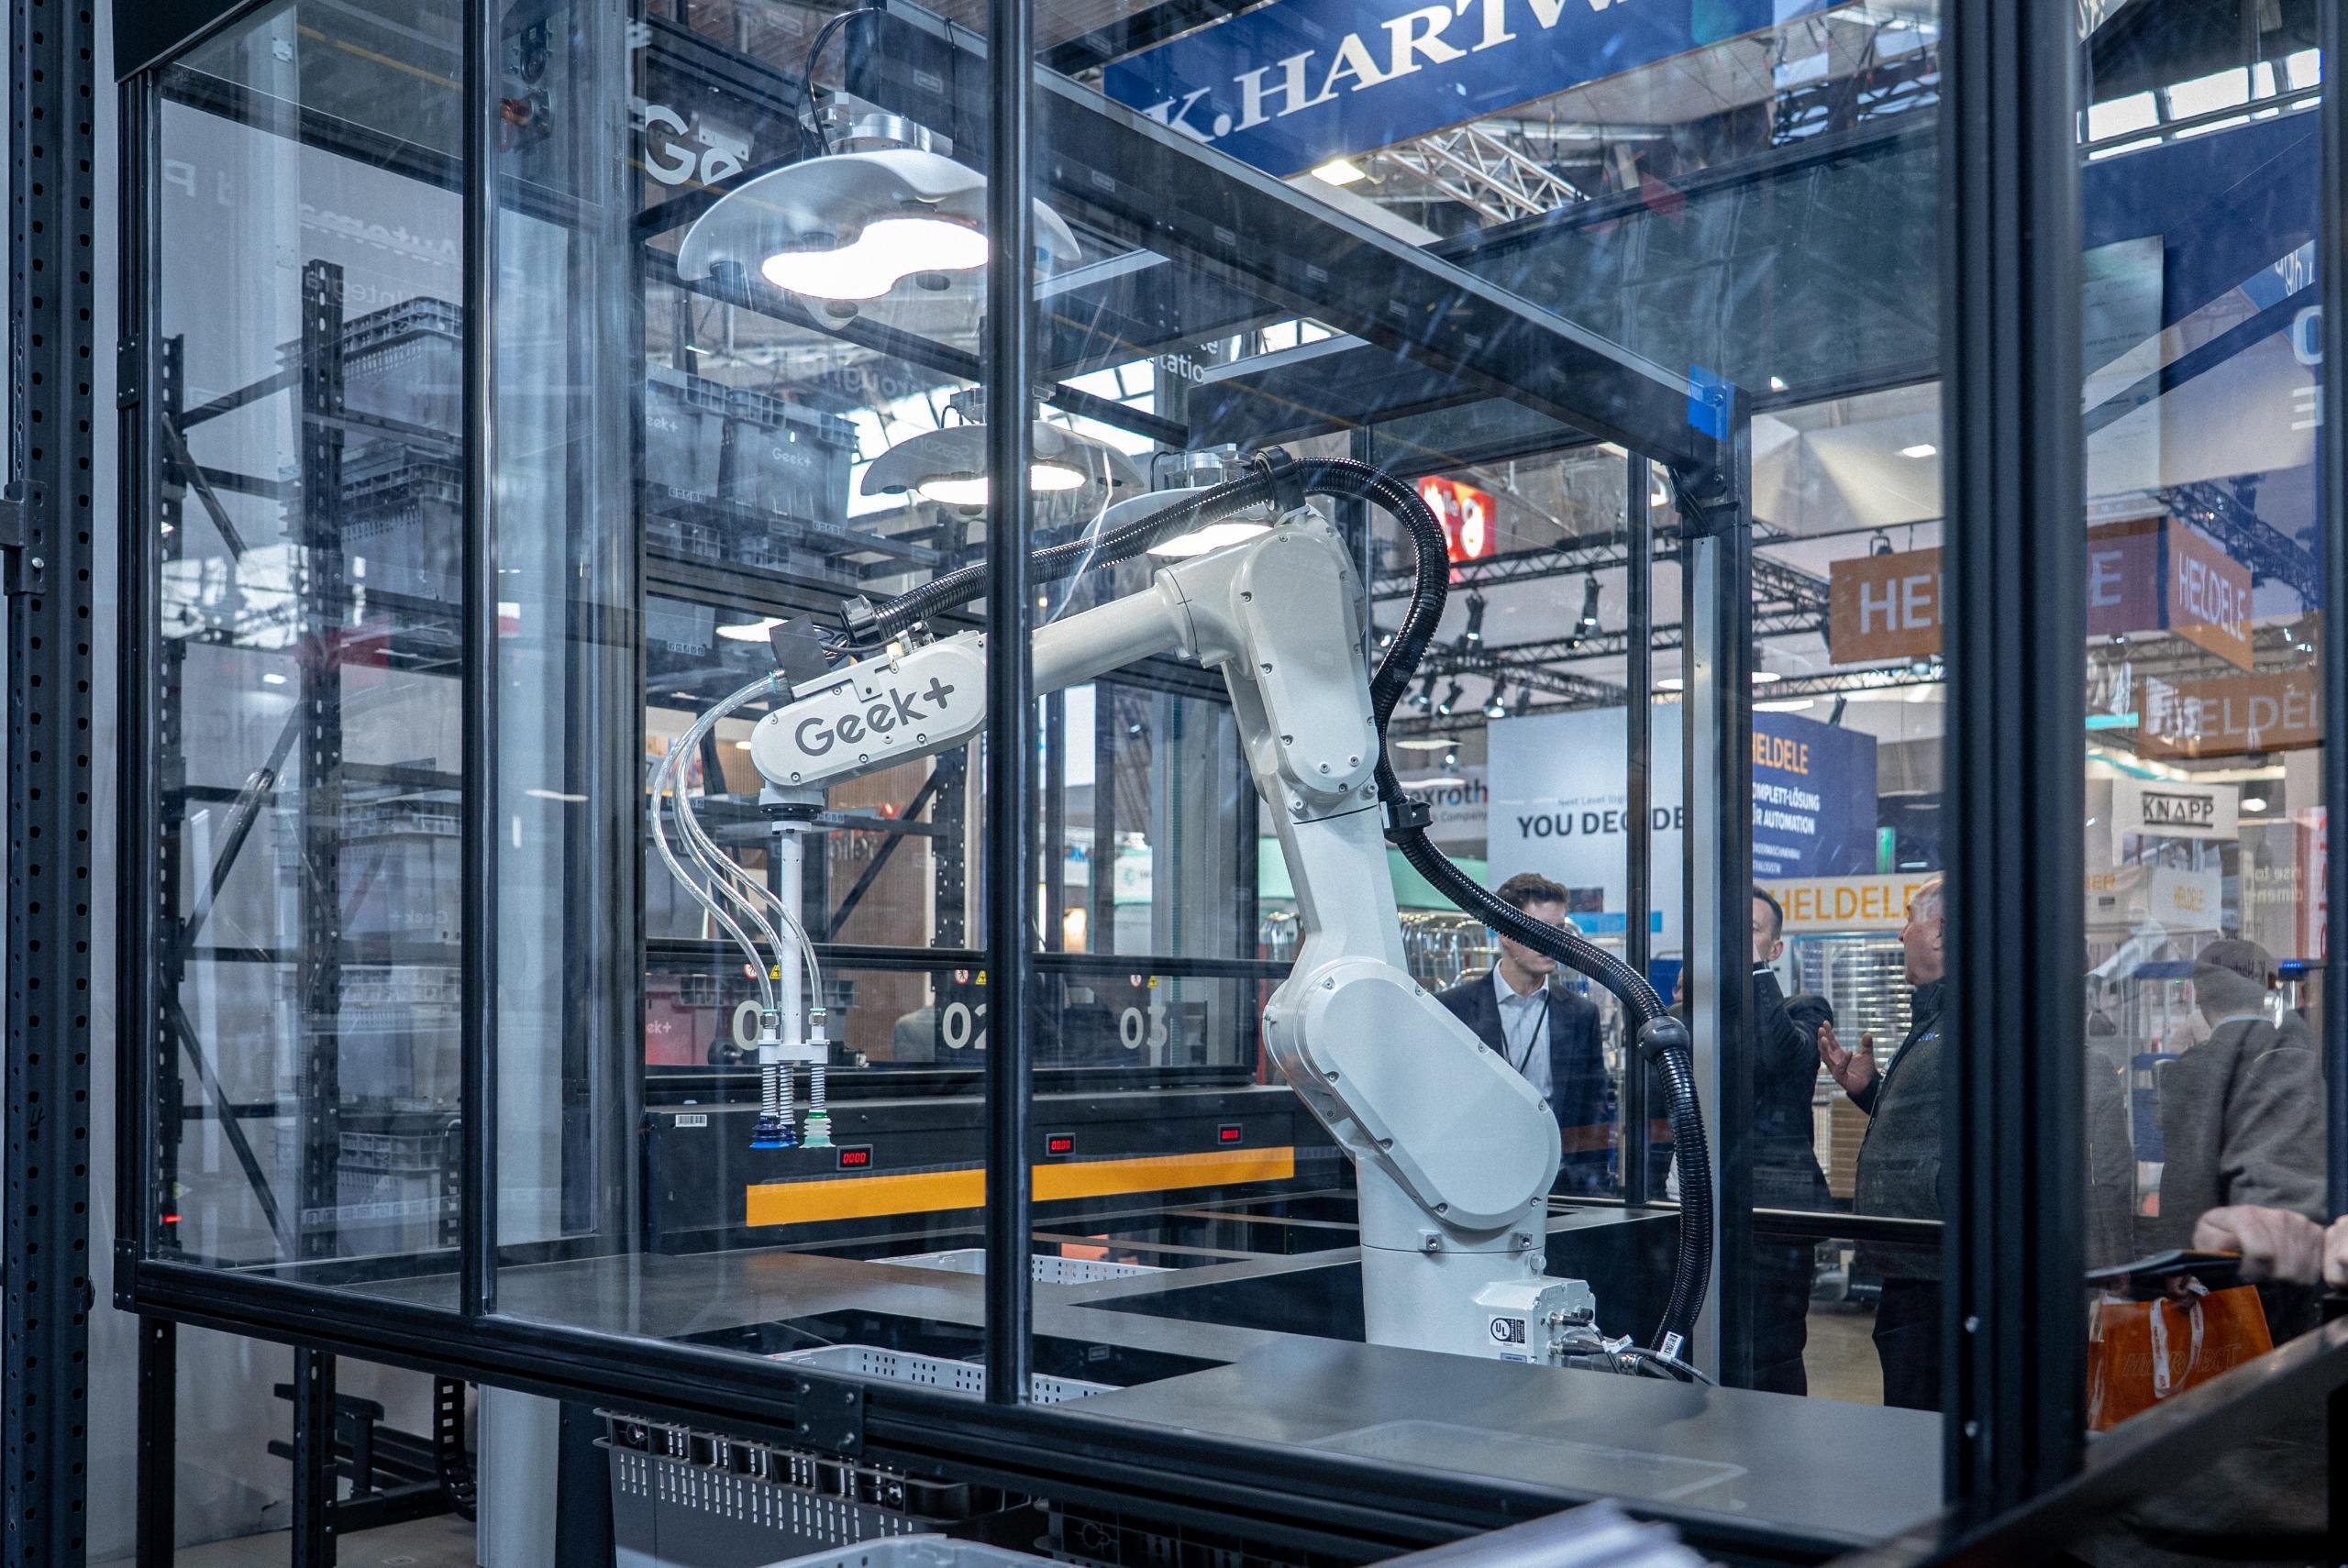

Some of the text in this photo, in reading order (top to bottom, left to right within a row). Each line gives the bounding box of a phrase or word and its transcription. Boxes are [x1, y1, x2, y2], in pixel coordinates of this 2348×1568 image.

[772, 447, 813, 469] Geek+
[2179, 552, 2246, 642] HELDELE
[795, 677, 955, 756] Geek+
[1763, 809, 1816, 835] AUTOMATION
[2143, 798, 2214, 822] KNAPP
[1518, 812, 1573, 839] YOU
